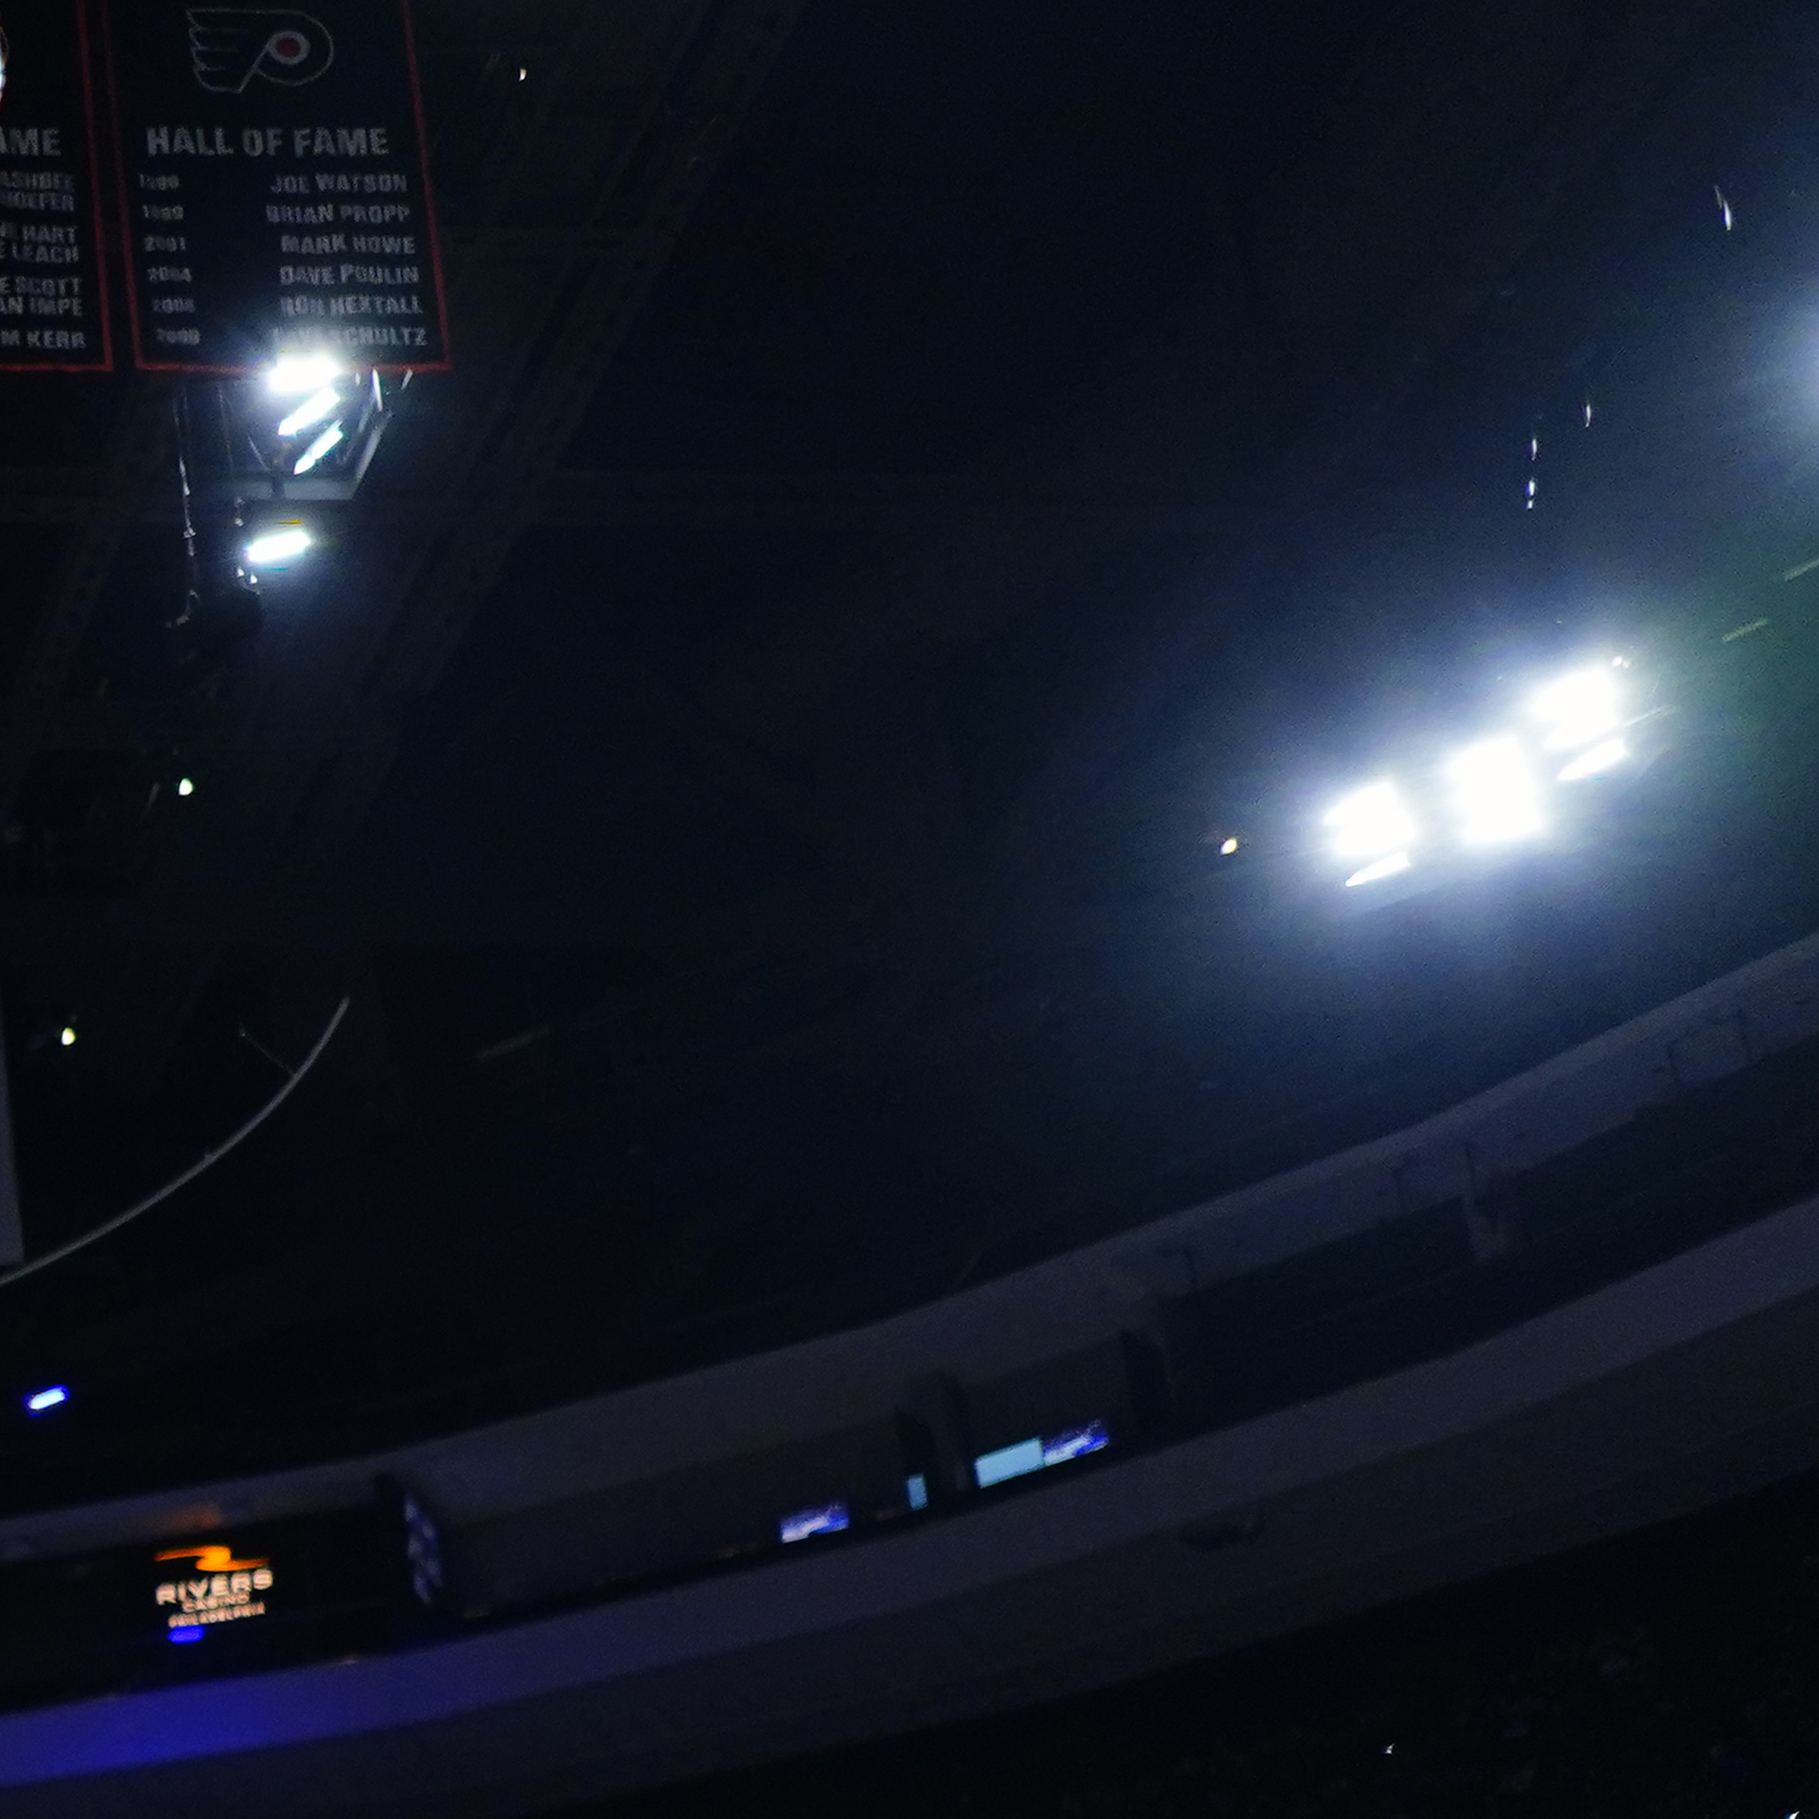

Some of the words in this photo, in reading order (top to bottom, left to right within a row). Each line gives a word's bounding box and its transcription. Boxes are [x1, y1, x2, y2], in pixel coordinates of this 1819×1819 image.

[146, 126, 234, 157] HALL
[241, 126, 284, 157] OF
[293, 126, 390, 158] FAME
[315, 173, 408, 193] WATSON
[280, 233, 346, 255] MARK
[339, 263, 418, 286] POULIN
[156, 1568, 274, 1606] RIVERS
[181, 1590, 251, 1612] CASINO
